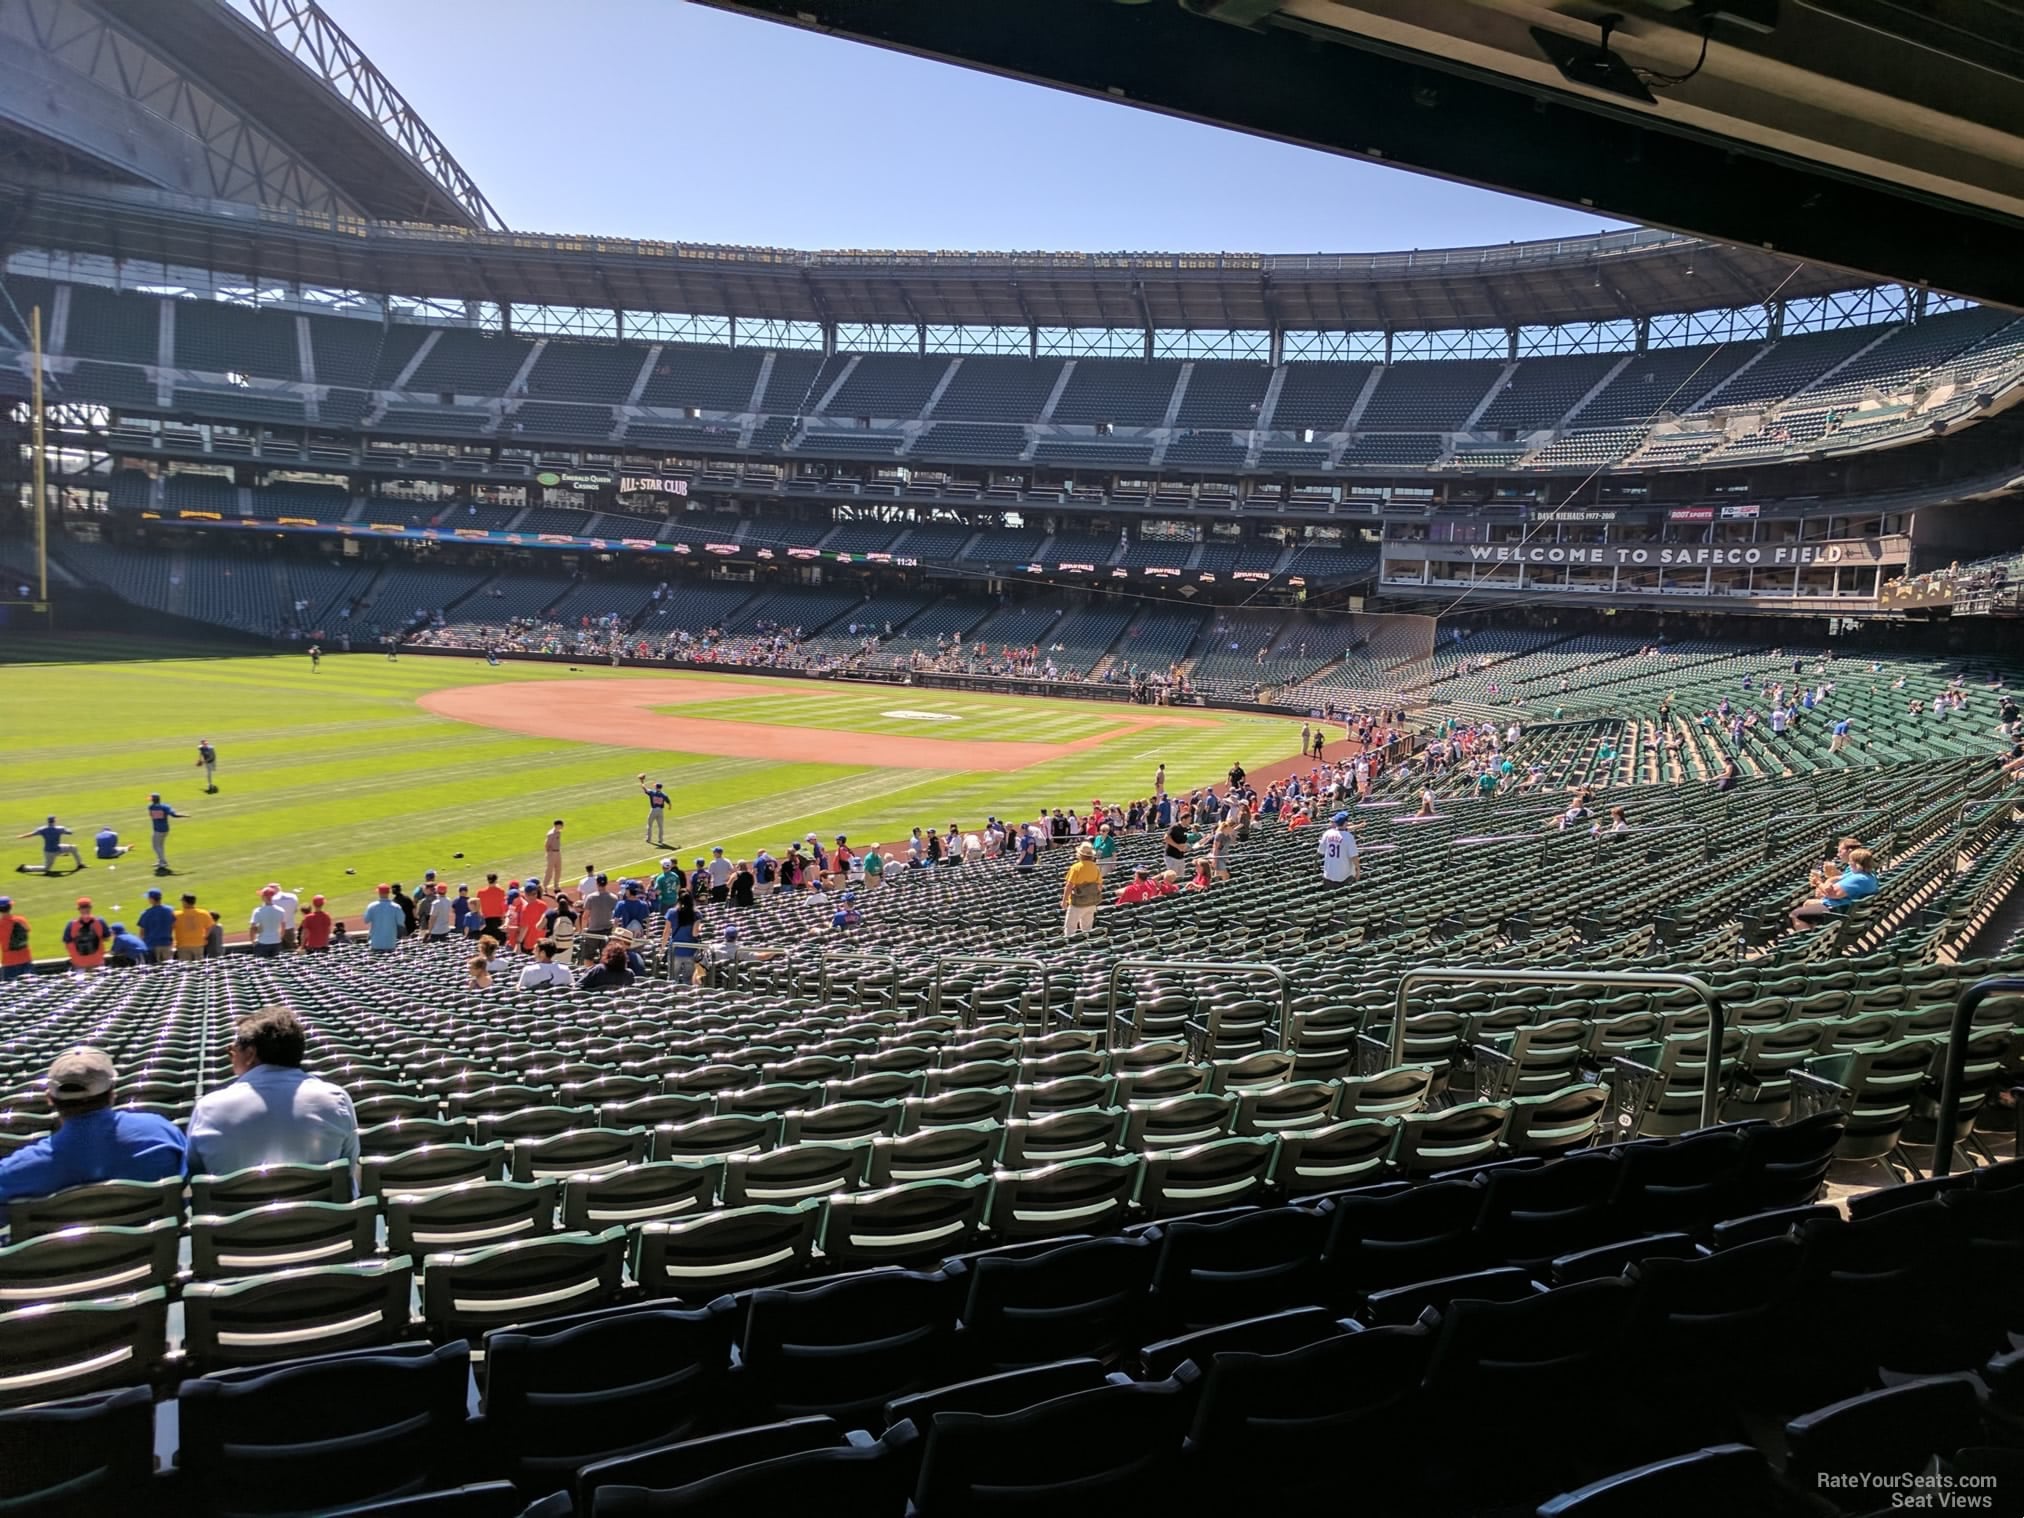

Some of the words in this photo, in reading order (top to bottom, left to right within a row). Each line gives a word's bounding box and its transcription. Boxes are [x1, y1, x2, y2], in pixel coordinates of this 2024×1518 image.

[562, 473, 589, 482] EMERALD
[590, 474, 611, 483] QUEEN
[573, 482, 599, 490] CASINOS
[664, 480, 688, 496] CLUB
[1537, 512, 1554, 520] DAVE
[1555, 512, 1585, 520] NIEHAUS
[1671, 511, 1689, 519] ROOT
[1470, 545, 1603, 562] WELCOME
[1617, 548, 1648, 563] TO
[1660, 548, 1761, 564] SAFECO
[1775, 546, 1841, 563] FIELD
[896, 558, 917, 566] 11:24
[1328, 843, 1340, 858] 31
